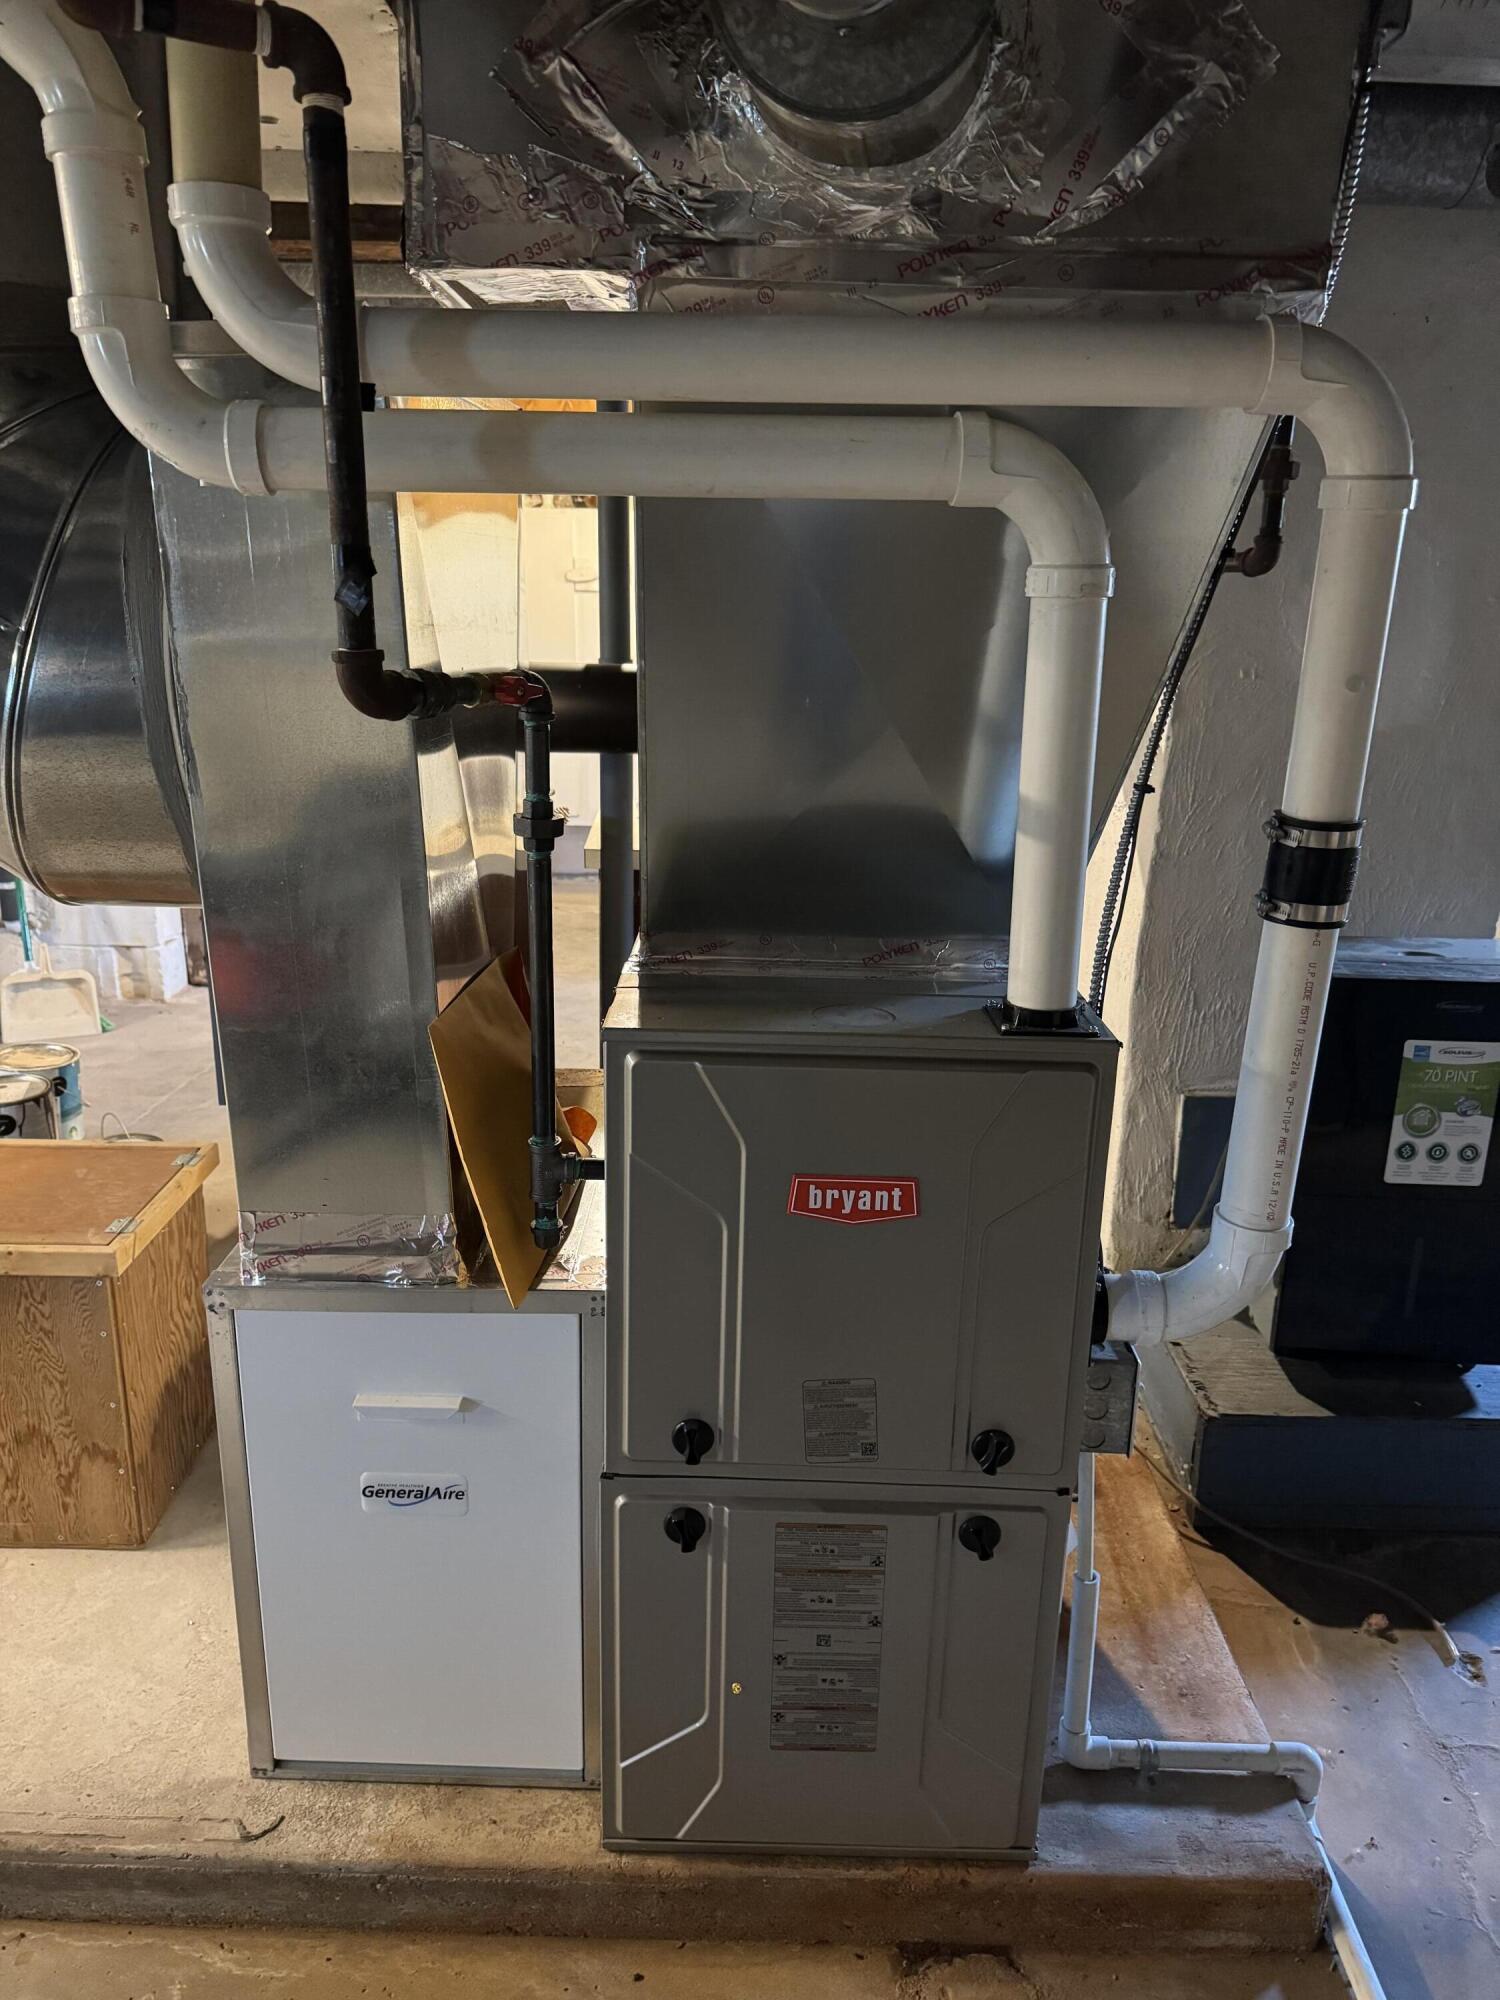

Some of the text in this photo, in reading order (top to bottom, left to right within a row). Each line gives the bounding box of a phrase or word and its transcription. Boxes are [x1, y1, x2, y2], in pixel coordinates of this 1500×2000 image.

[524, 237, 551, 260] 339
[863, 941, 920, 967] POLYKEN
[1424, 1069, 1479, 1083] 70 PINT
[1277, 1135, 1288, 1155] MADE
[1274, 1159, 1284, 1169] IN
[808, 1184, 902, 1214] bryant
[362, 1485, 465, 1501] GeneralAire
